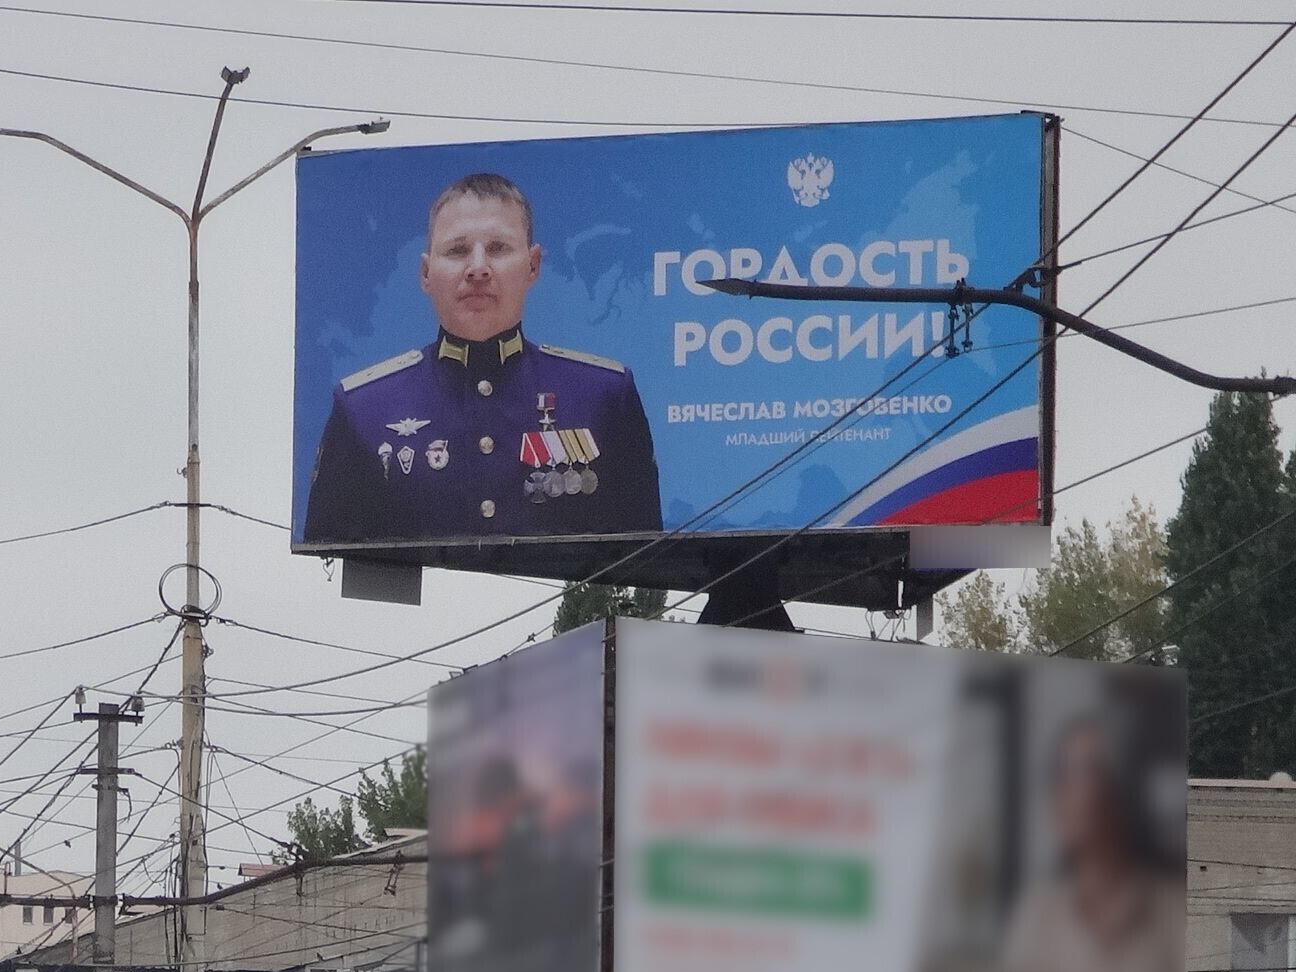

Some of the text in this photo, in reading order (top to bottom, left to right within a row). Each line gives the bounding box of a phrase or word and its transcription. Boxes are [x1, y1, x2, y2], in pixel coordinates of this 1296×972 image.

[654, 239, 969, 296] ГОРДОСТЬ
[674, 310, 946, 367] РОССИИ!
[667, 394, 953, 424] ВЯЧЕСЛАВ МОЗГОВЕНКО
[725, 428, 806, 447] МЛАДШИЙ
